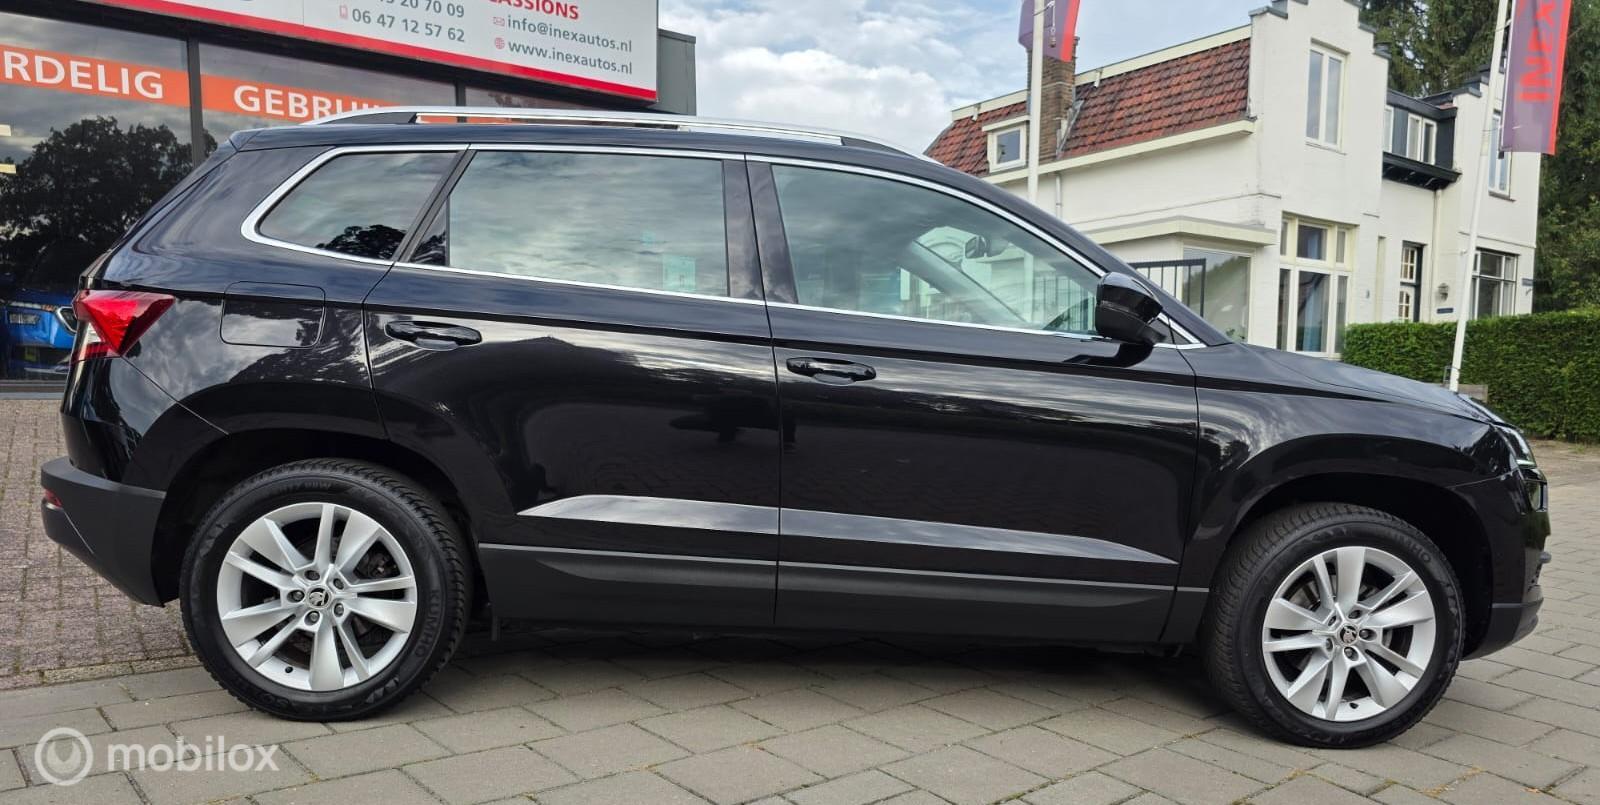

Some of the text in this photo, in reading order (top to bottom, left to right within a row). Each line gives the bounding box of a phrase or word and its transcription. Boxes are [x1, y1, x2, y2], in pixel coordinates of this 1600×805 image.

[352, 8, 465, 42] 06 47 12 57 62
[425, 0, 442, 13] 70
[447, 3, 464, 18] 09
[487, 0, 578, 20] SIONS
[507, 15, 632, 52] info@inexautos.nl
[508, 40, 633, 74] www.inexautos.nl
[4, 50, 164, 99] RDELIG
[414, 589, 440, 658] KUMHO
